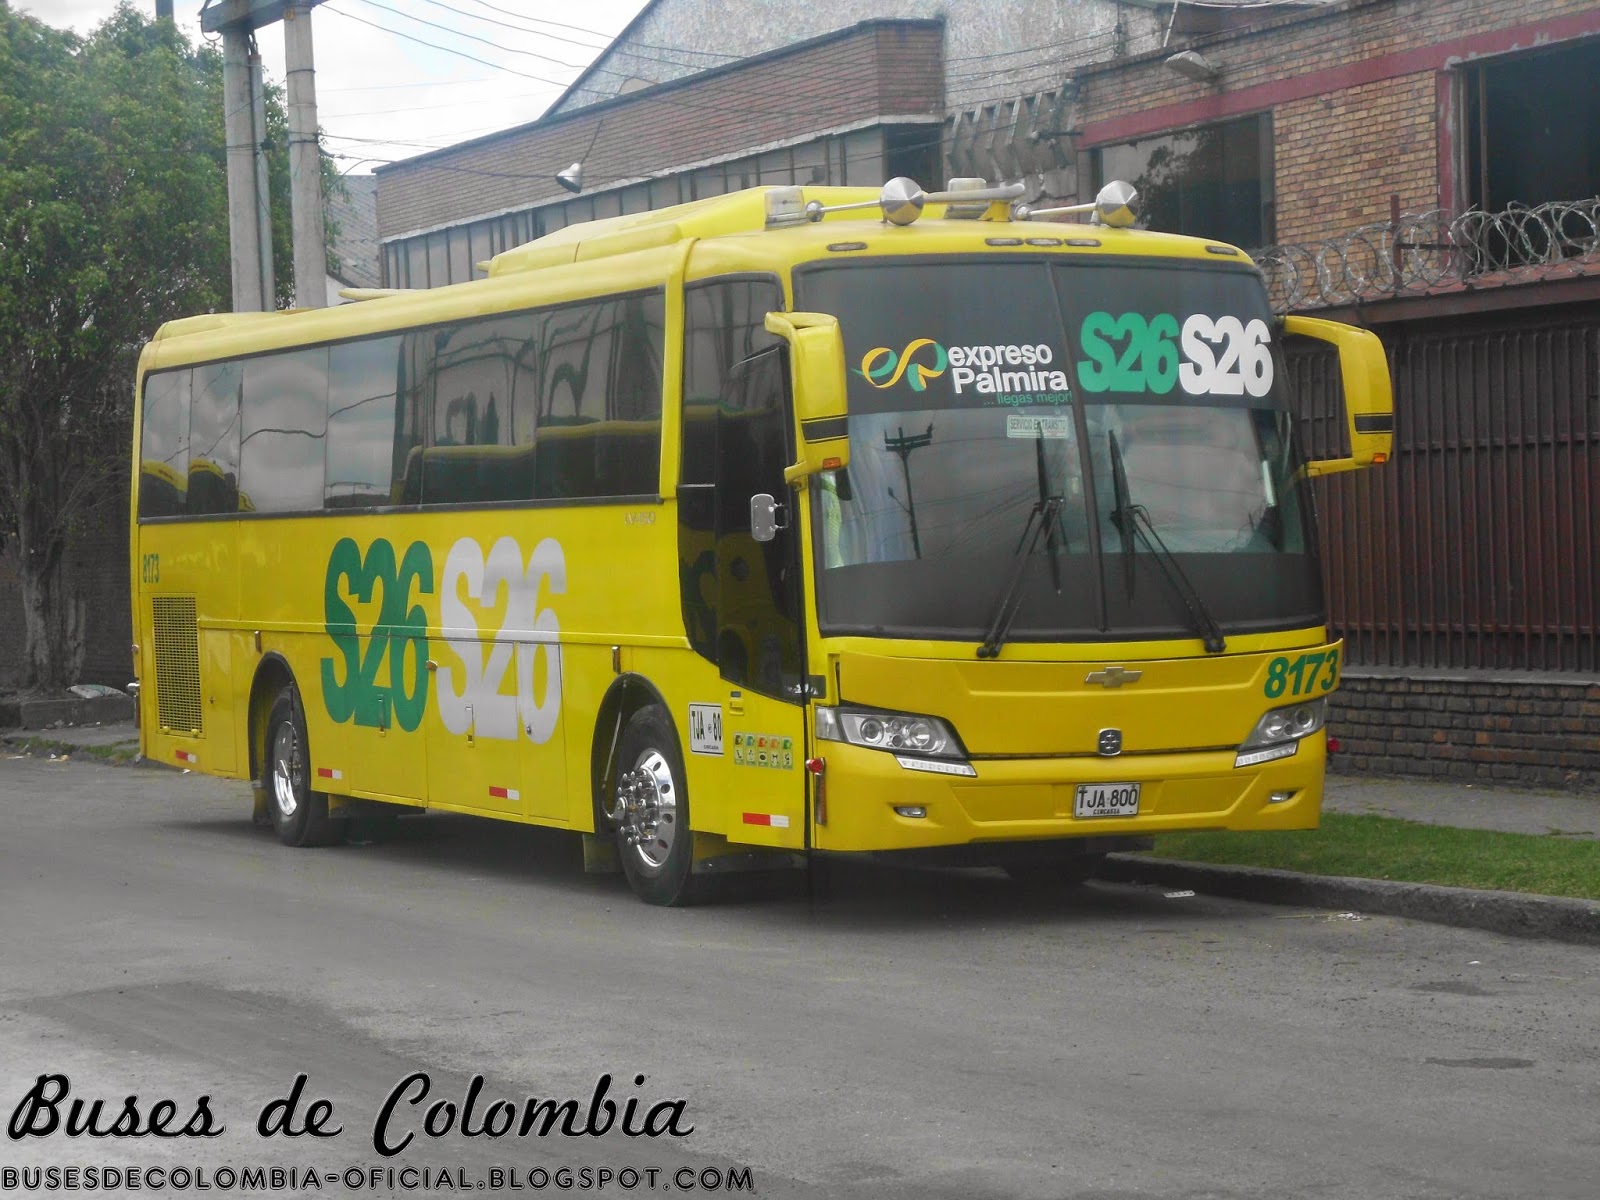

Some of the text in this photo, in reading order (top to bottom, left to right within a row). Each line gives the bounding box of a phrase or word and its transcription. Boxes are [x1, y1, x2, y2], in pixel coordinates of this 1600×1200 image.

[948, 343, 1053, 372] expreso
[1077, 311, 1275, 398] S26 S26
[952, 365, 1070, 394] Palmira
[142, 553, 160, 584] 8173
[320, 536, 568, 745] S26 S26
[1263, 649, 1339, 699] 8173
